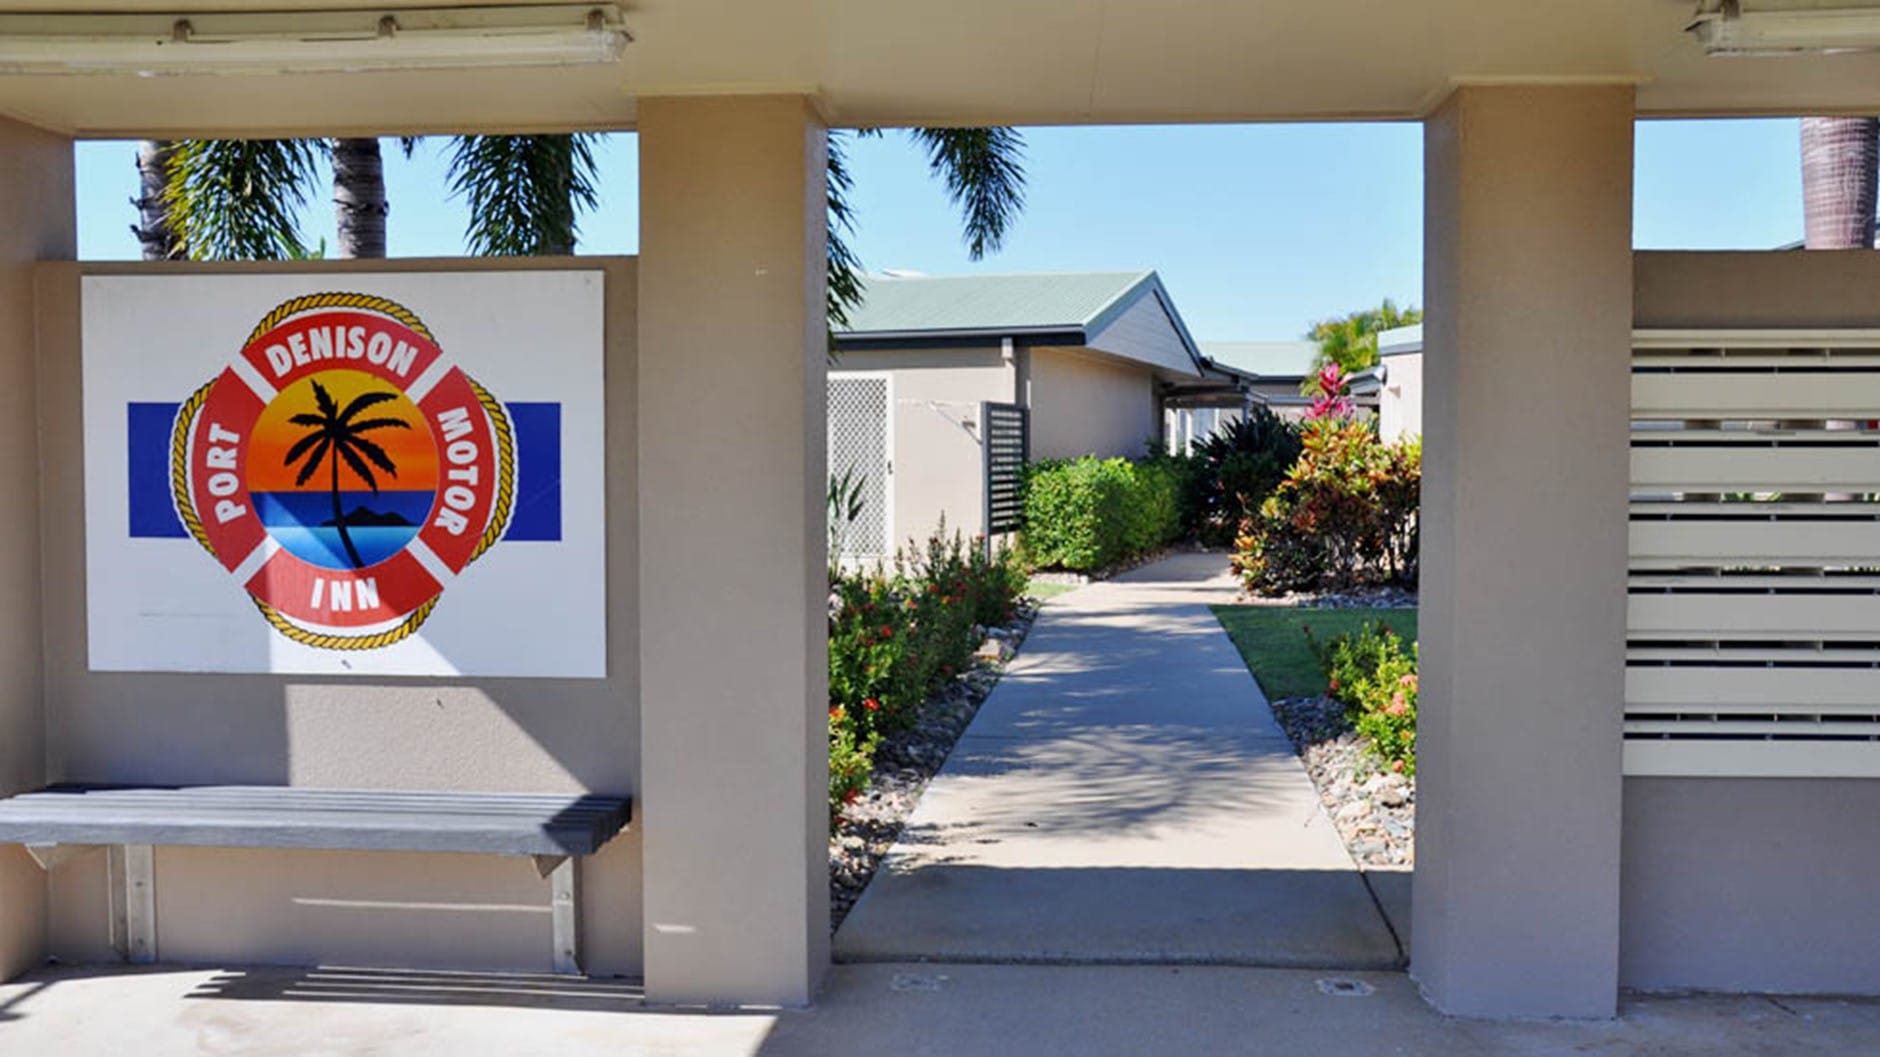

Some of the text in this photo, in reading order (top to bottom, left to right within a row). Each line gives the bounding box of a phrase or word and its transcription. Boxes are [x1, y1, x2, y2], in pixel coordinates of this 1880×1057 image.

[266, 326, 418, 377] DENISON
[207, 423, 246, 523] PORT
[435, 407, 478, 536] MOTOR
[310, 577, 380, 611] INN
